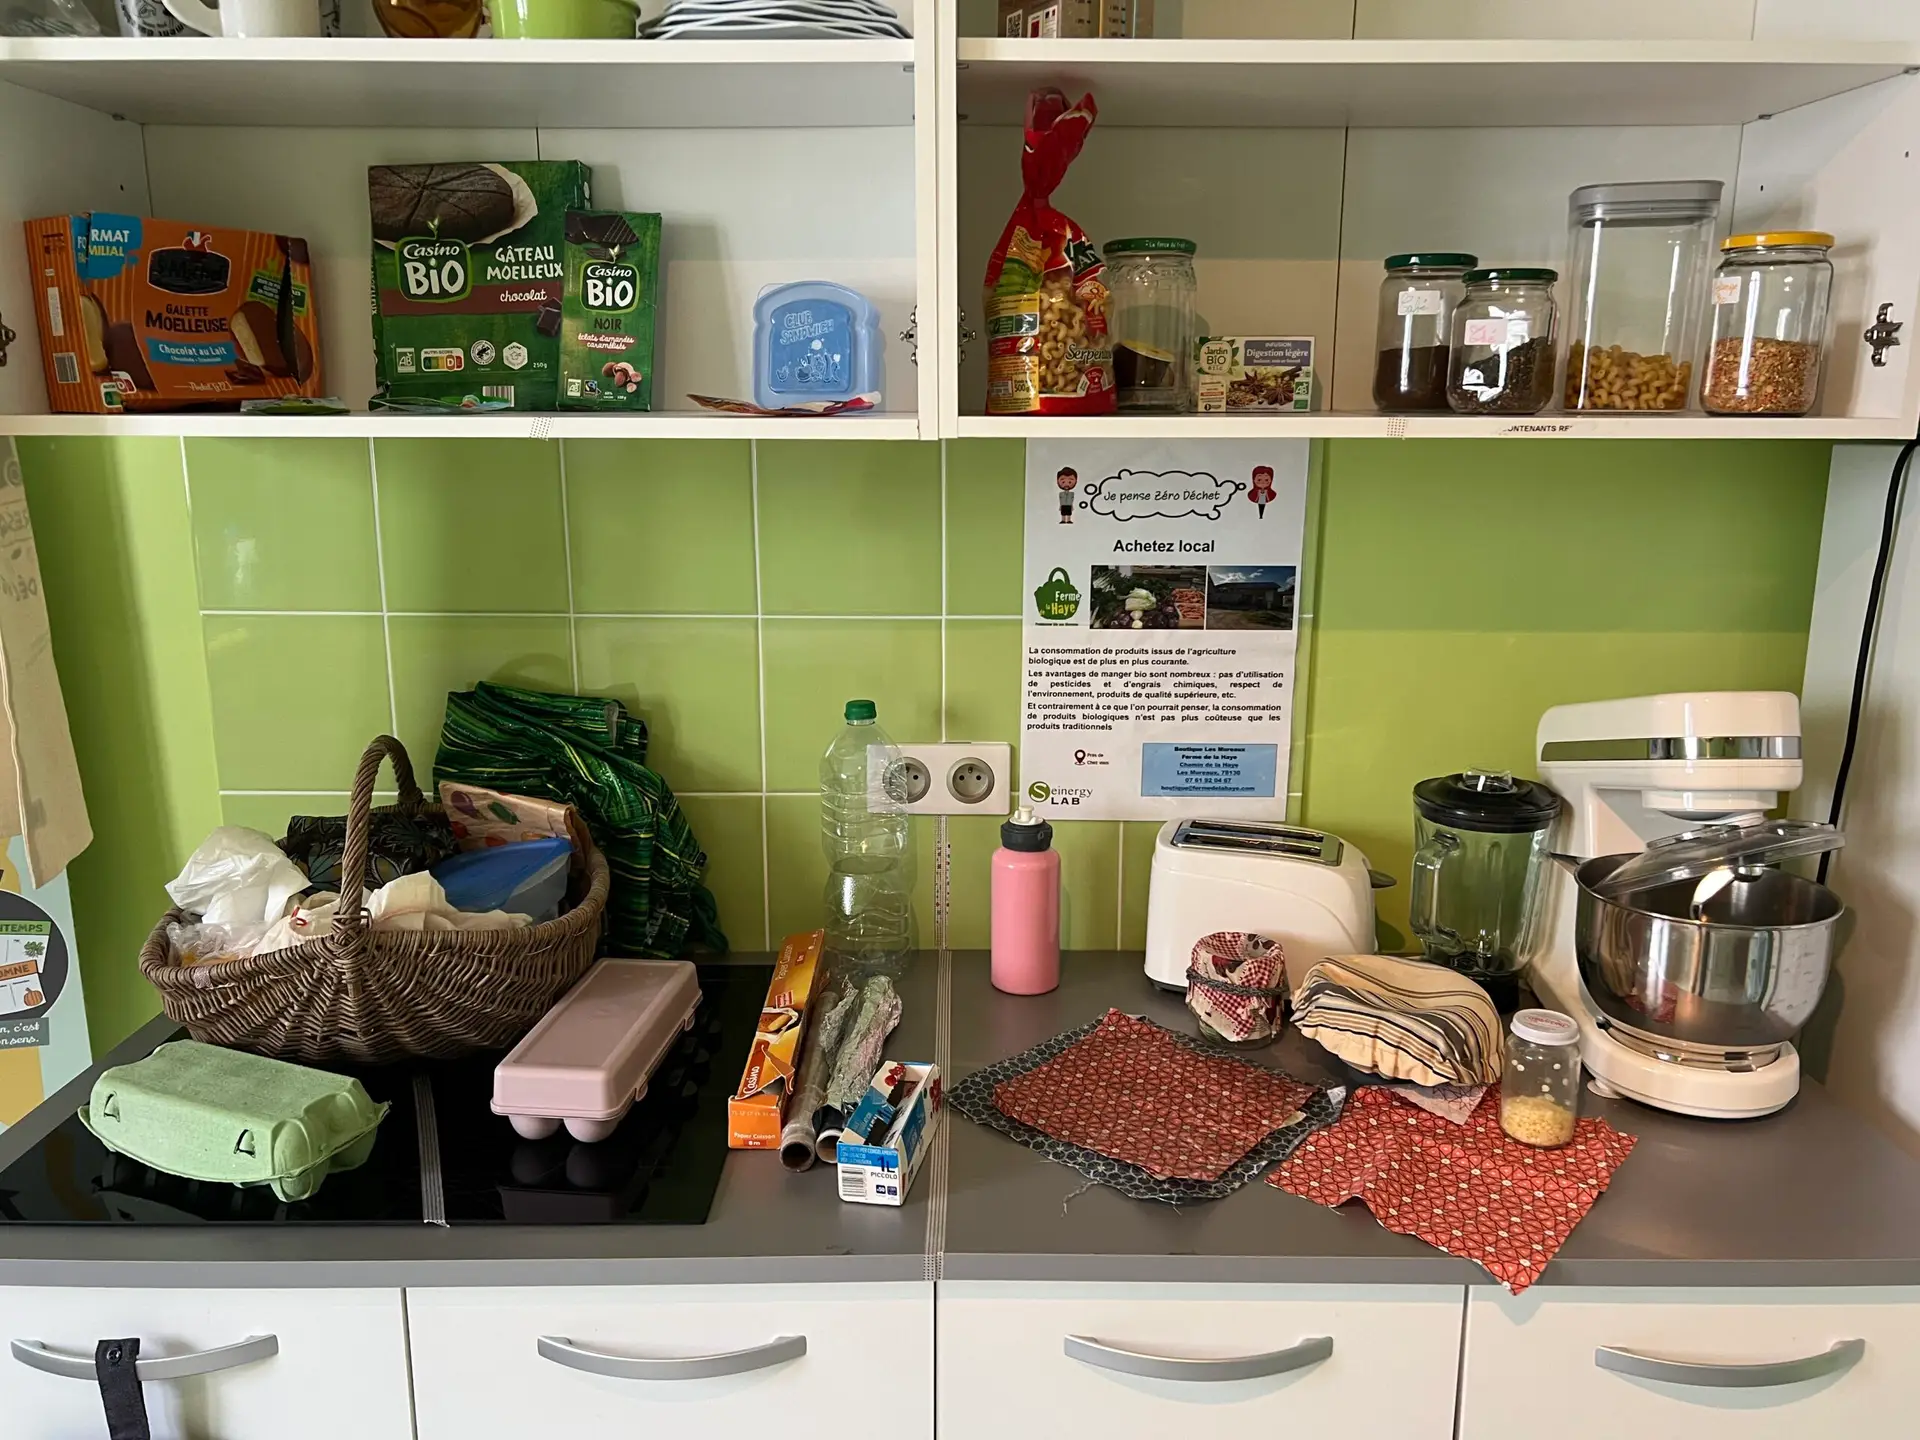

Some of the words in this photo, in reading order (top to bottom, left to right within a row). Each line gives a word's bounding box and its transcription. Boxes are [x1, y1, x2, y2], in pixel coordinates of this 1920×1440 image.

[403, 243, 460, 259] Casino
[496, 246, 554, 263] GÂTEAU
[487, 263, 563, 280] MOELLEUX
[587, 265, 632, 278] Casino
[500, 288, 547, 302] chocolat
[166, 304, 208, 316] GALETTE
[594, 318, 622, 330] NOIR
[784, 310, 812, 329] CLUB
[780, 319, 834, 345] SANDWICH
[159, 344, 198, 355] Chocolat
[211, 346, 227, 355] Lait
[1204, 346, 1228, 355] Jardin
[1247, 349, 1283, 358] Digestion
[1285, 349, 1308, 358] légère
[1104, 492, 1116, 500] Je
[1120, 492, 1151, 503] pense
[1155, 491, 1179, 500] Zéro
[1183, 490, 1220, 500] Déchet
[1113, 540, 1174, 552] Achetez
[1179, 540, 1214, 552] local
[1056, 591, 1080, 601] Ferme
[1052, 603, 1075, 616] Haye
[1115, 648, 1149, 656] produits
[1187, 648, 1236, 656] l'agriculture
[1028, 657, 1071, 666] biologique
[1100, 658, 1117, 666] plus
[1132, 658, 1149, 666] plus
[1050, 680, 1091, 688] pesticides
[1123, 681, 1161, 689] d'engrais
[1173, 681, 1217, 689] chimiques,
[1230, 681, 1260, 689] respect
[1097, 690, 1130, 699] produits
[1145, 691, 1172, 699] qualité
[1174, 691, 1219, 699] supérieure,
[1147, 704, 1179, 712] pourrait
[1043, 712, 1076, 720] produits
[1082, 713, 1129, 722] biologiques
[1181, 714, 1198, 722] plus
[1051, 797, 1080, 805] LAB
[14, 1022, 39, 1032] c'est
[743, 1066, 759, 1093] Casino
[871, 1171, 897, 1179] PICCOLO
